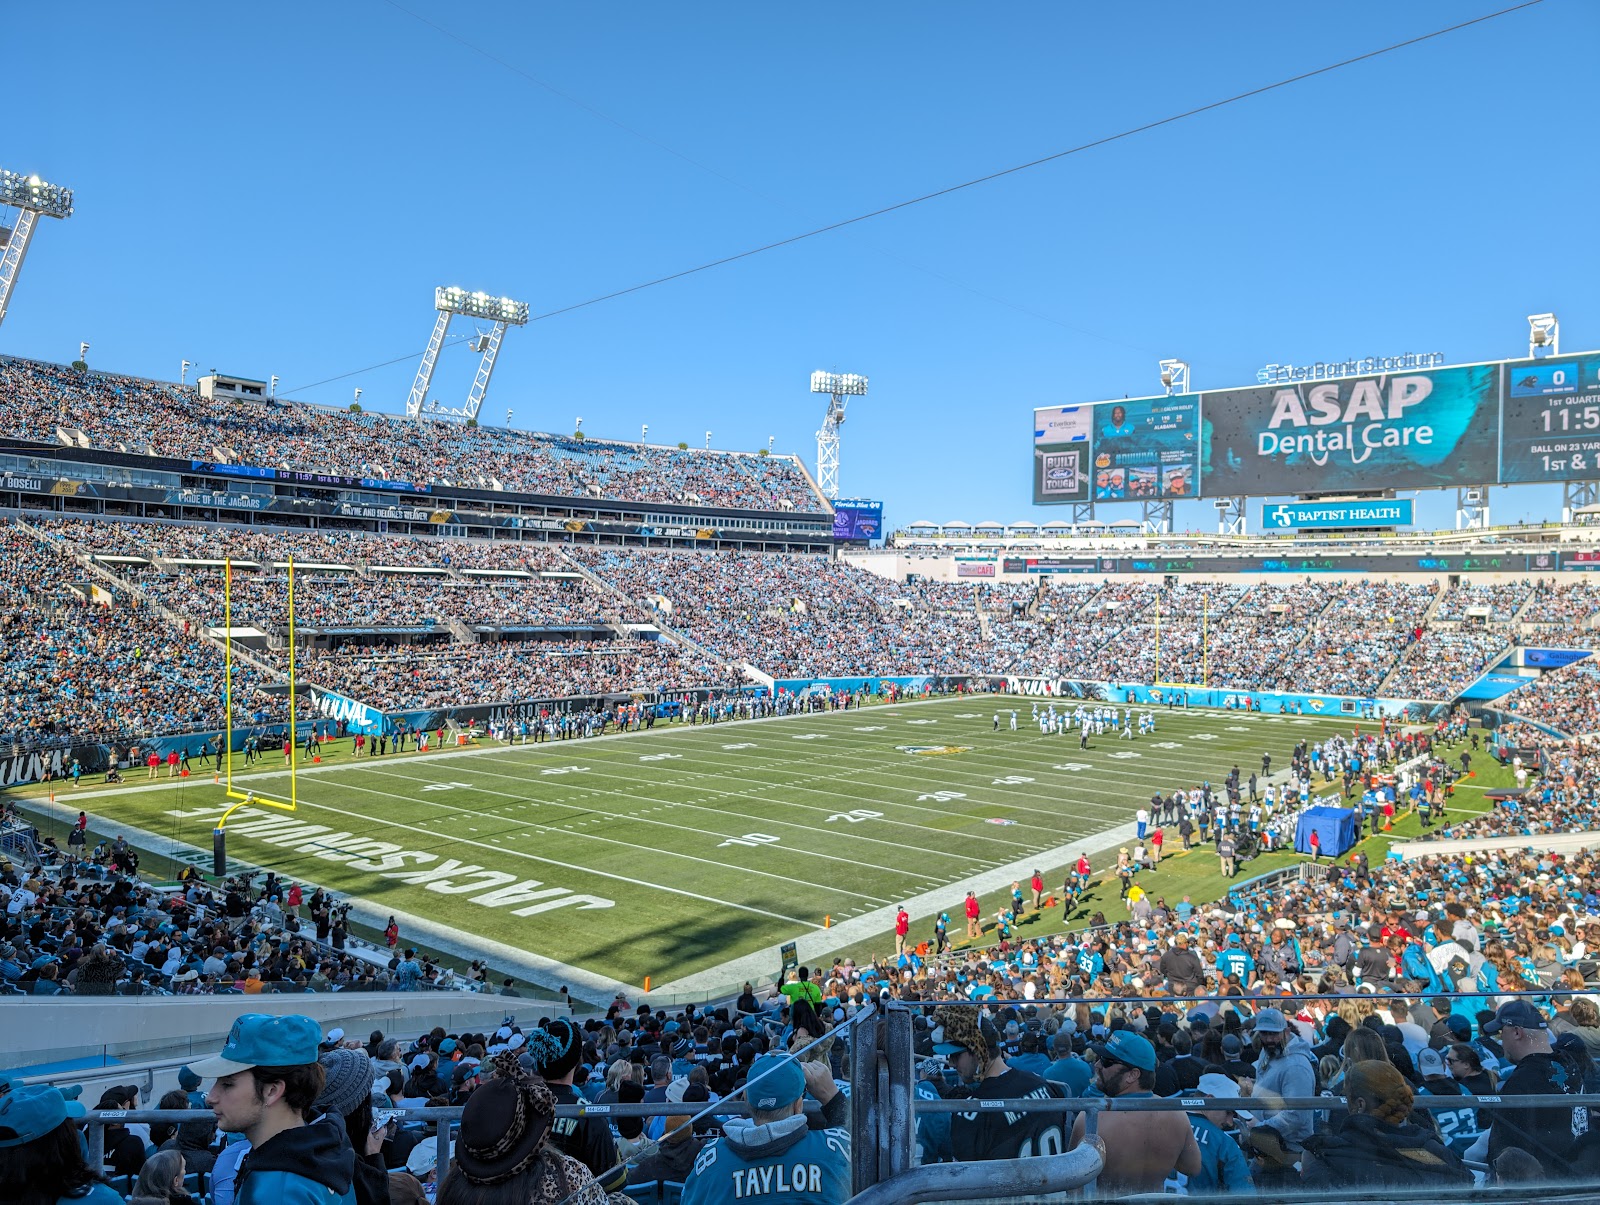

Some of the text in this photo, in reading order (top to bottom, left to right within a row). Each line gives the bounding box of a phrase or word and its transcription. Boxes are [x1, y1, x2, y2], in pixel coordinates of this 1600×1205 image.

[1275, 352, 1444, 381] EverBank Stadium
[1552, 370, 1566, 386] 0
[1268, 375, 1433, 429] ASAP
[1257, 423, 1434, 456] Dental Care
[1531, 445, 1552, 454] BALL
[1554, 444, 1568, 452] ON
[1568, 443, 1580, 451] 23
[1047, 456, 1075, 468] BUILT
[1571, 453, 1587, 469] &
[279, 471, 291, 479] 1ST
[295, 473, 313, 481] 11:57
[7, 478, 41, 491] BOSELLI
[1046, 479, 1075, 489] TOUGH
[179, 492, 260, 508] PRIDE OF THE JAGUARS
[363, 507, 376, 517] AND
[1298, 508, 1400, 522] BAPTIST HEALTH
[977, 566, 994, 575] CAFE
[539, 765, 591, 776] 20
[419, 781, 473, 793] 10
[915, 790, 967, 802] 30
[824, 809, 884, 823] 20
[716, 832, 780, 847] 10
[1230, 961, 1245, 978] 16
[732, 1163, 823, 1199] TAYLOR
